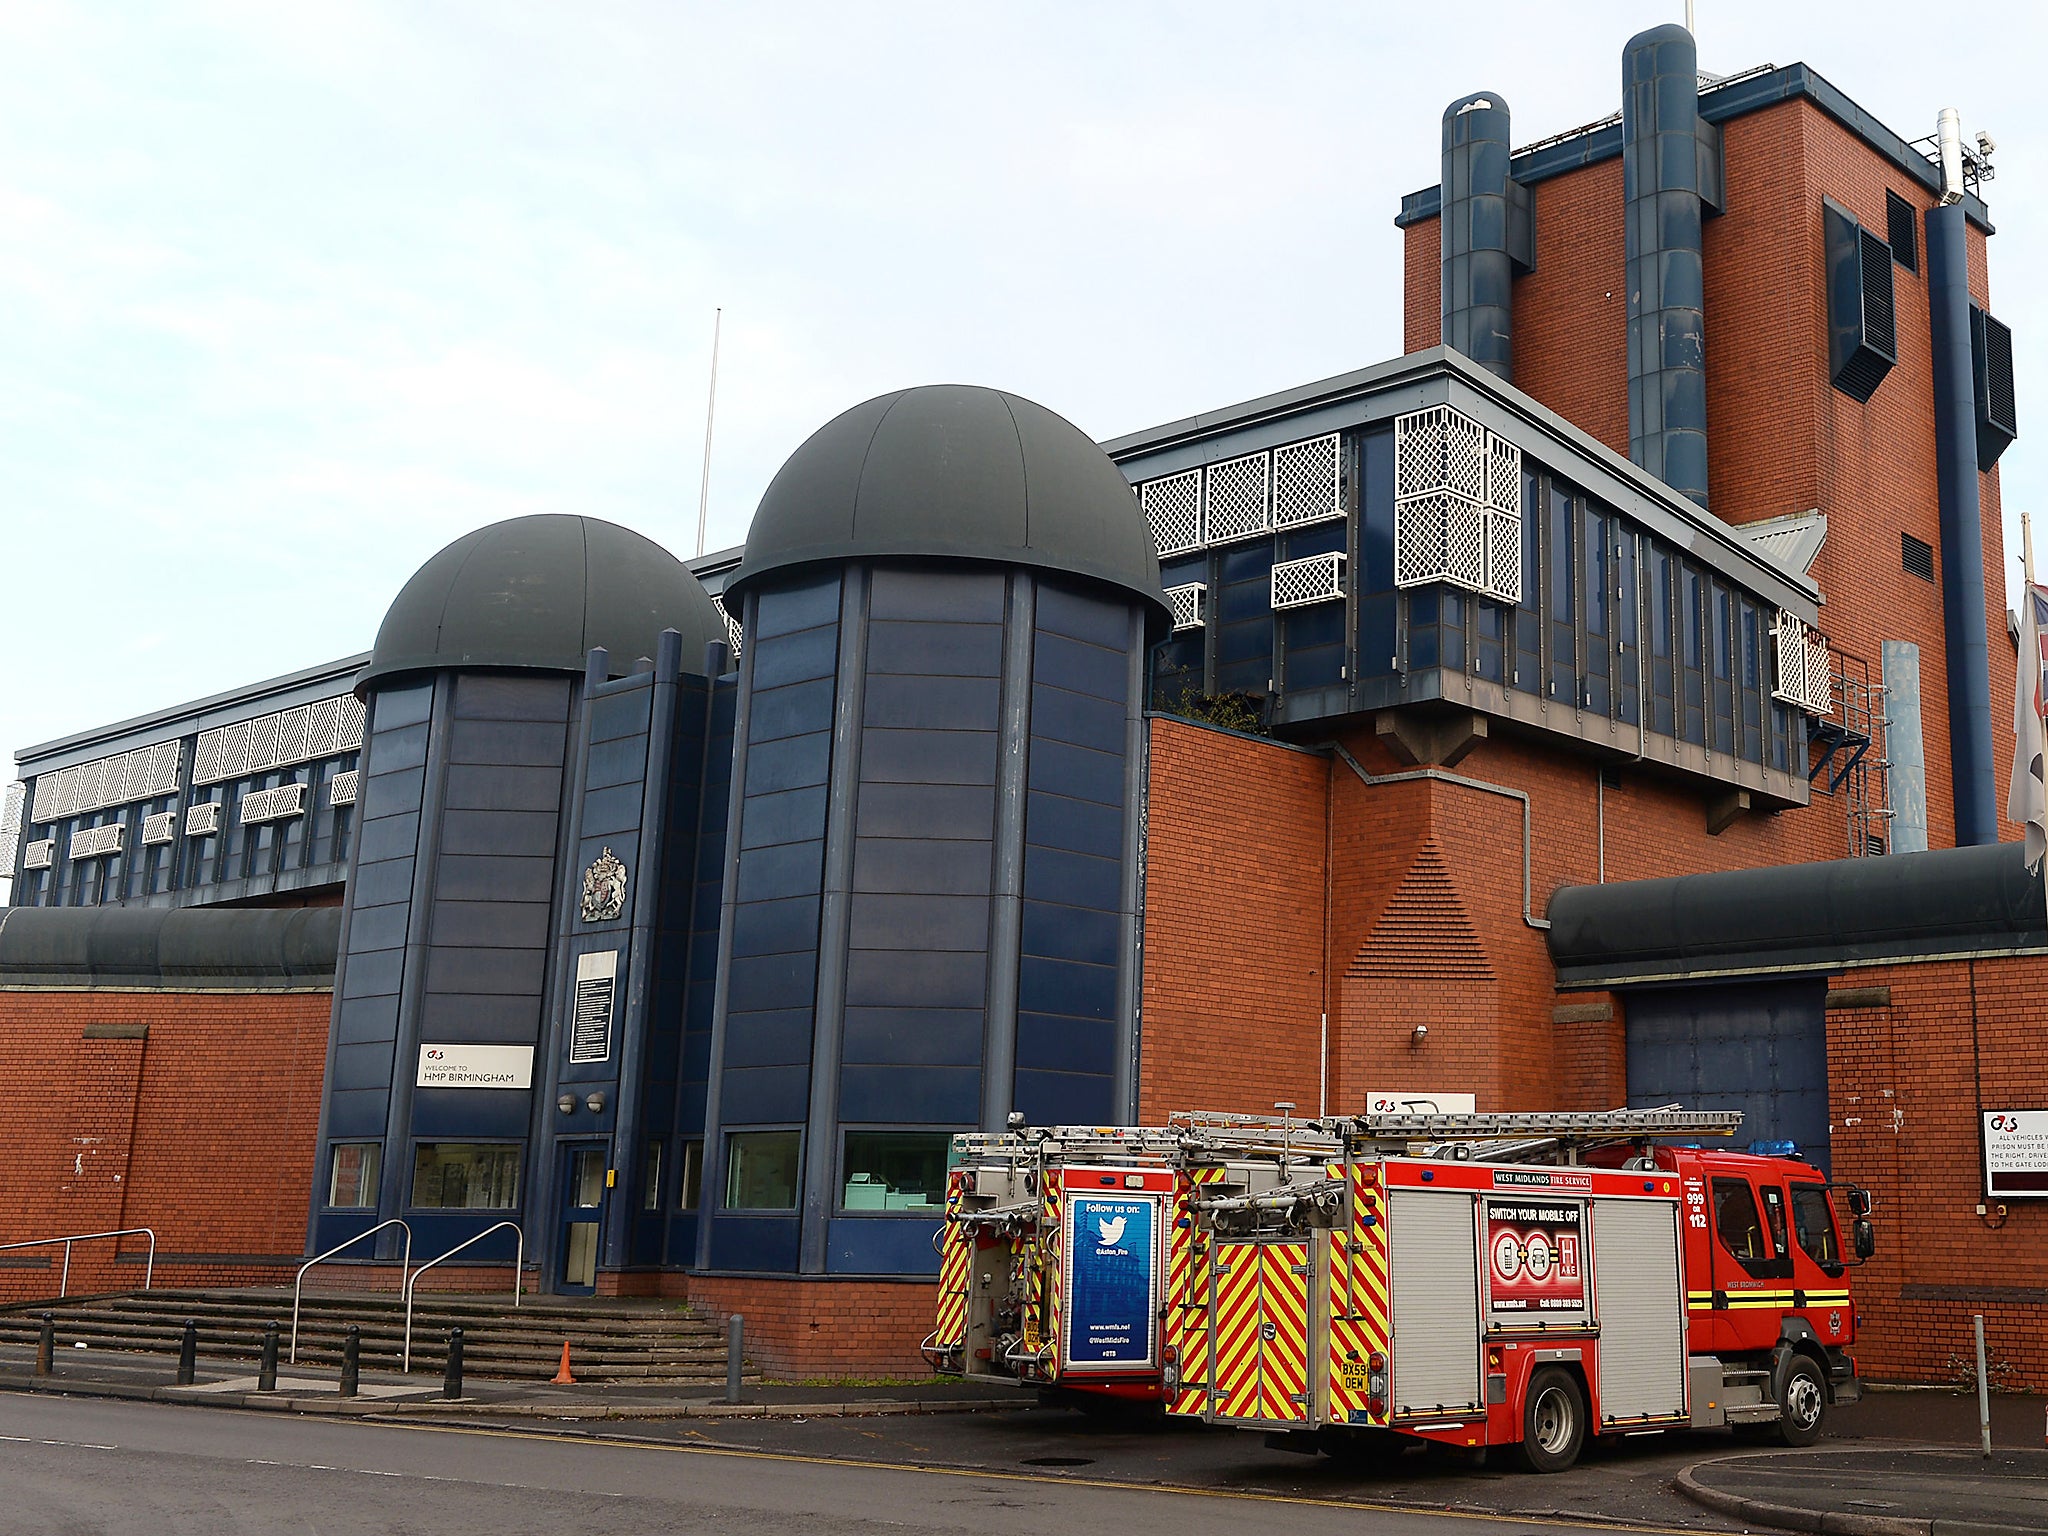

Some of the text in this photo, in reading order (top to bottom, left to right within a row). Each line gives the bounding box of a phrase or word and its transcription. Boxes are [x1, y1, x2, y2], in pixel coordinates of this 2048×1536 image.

[424, 1073, 514, 1082] HMP BIRMINGHAM
[1495, 1173, 1590, 1186] WEST MIDLANDS FIRE SERVICE
[1686, 1192, 1704, 1205] 999
[1086, 1203, 1140, 1214] Follow us on:
[1489, 1207, 1579, 1223] SWITCH YOUR MOBILE OFF
[1689, 1213, 1707, 1228] 112
[1342, 1363, 1367, 1376] BX59
